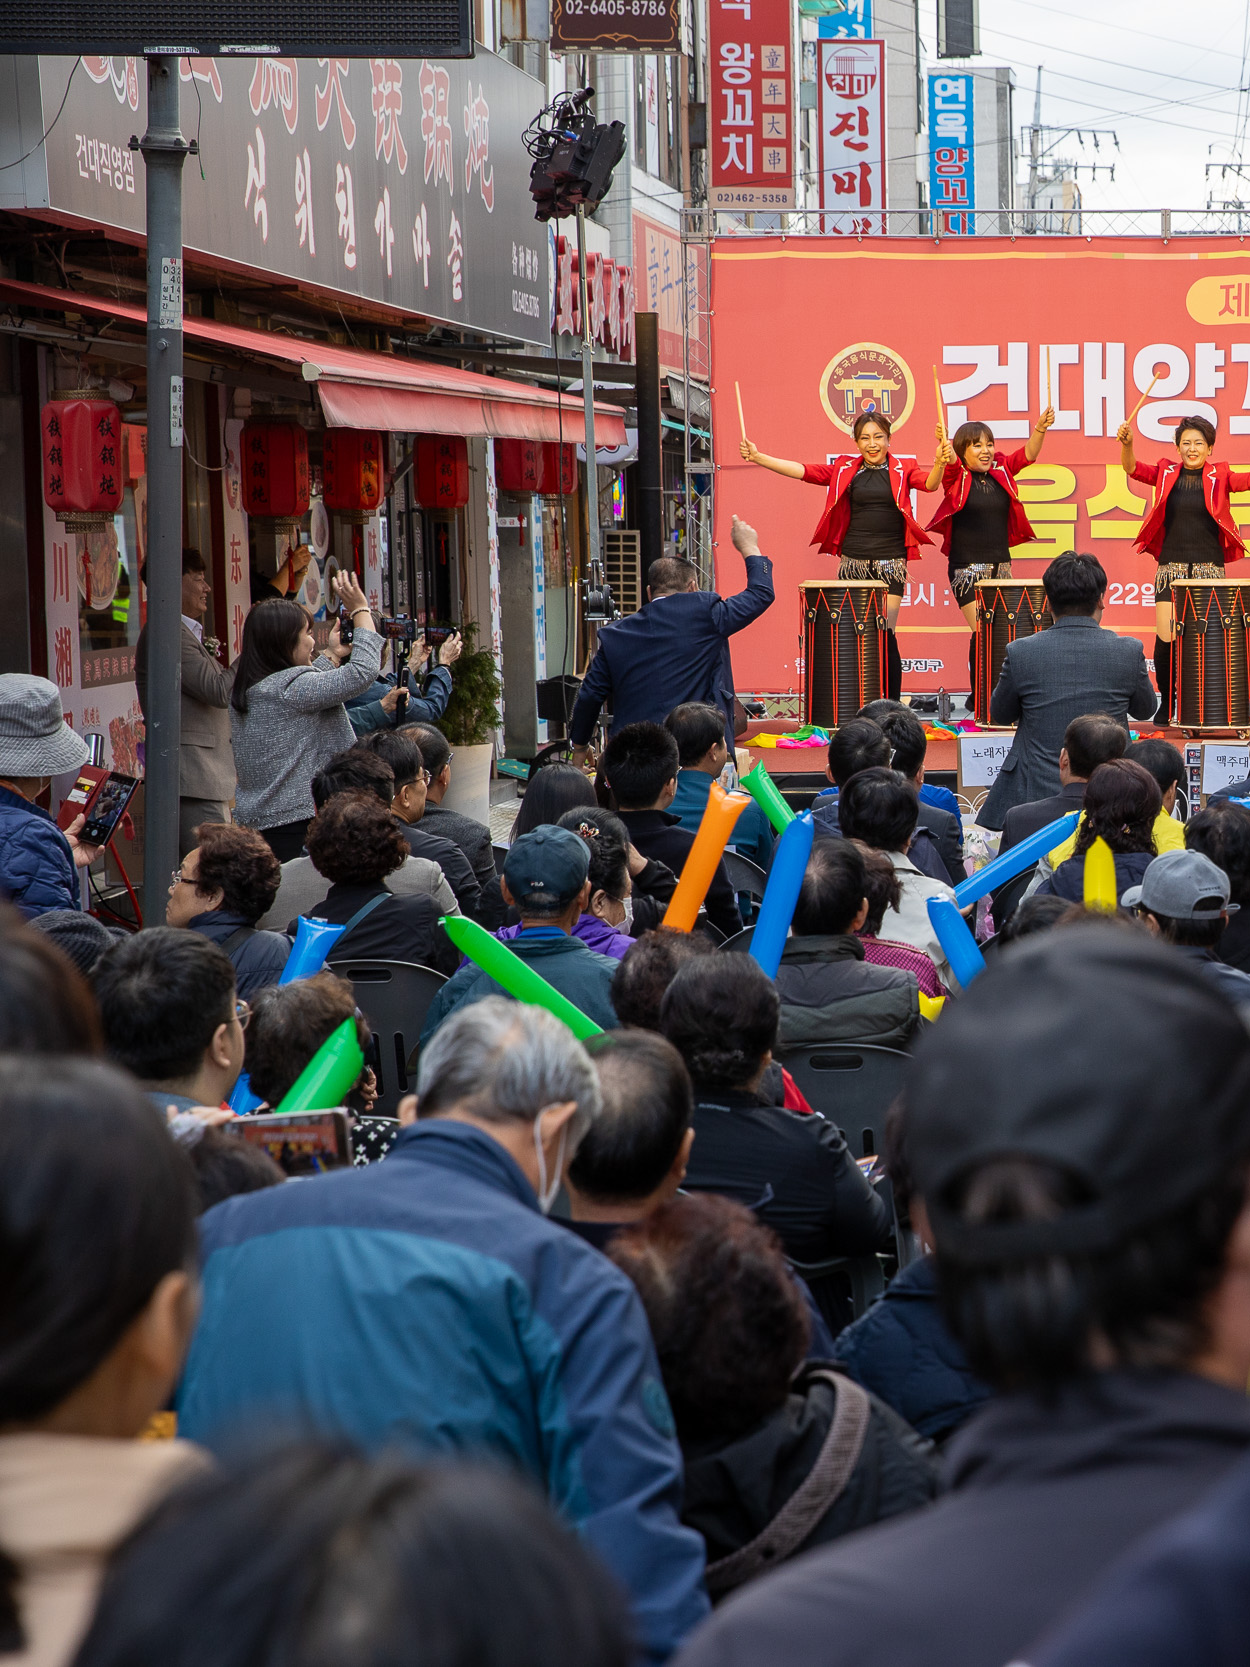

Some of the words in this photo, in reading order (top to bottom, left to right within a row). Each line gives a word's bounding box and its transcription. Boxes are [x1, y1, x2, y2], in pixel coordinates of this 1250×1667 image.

[565, 0, 666, 16] 02-6405-8786
[832, 75, 872, 96] 진미
[719, 42, 755, 174] 왕꼬치
[764, 48, 782, 172] 童年大串
[75, 133, 136, 194] 건대직영점
[717, 193, 788, 204] 02)462-5358
[834, 350, 902, 377] 중국음식문화거리
[97, 416, 117, 496] 铁锅炖
